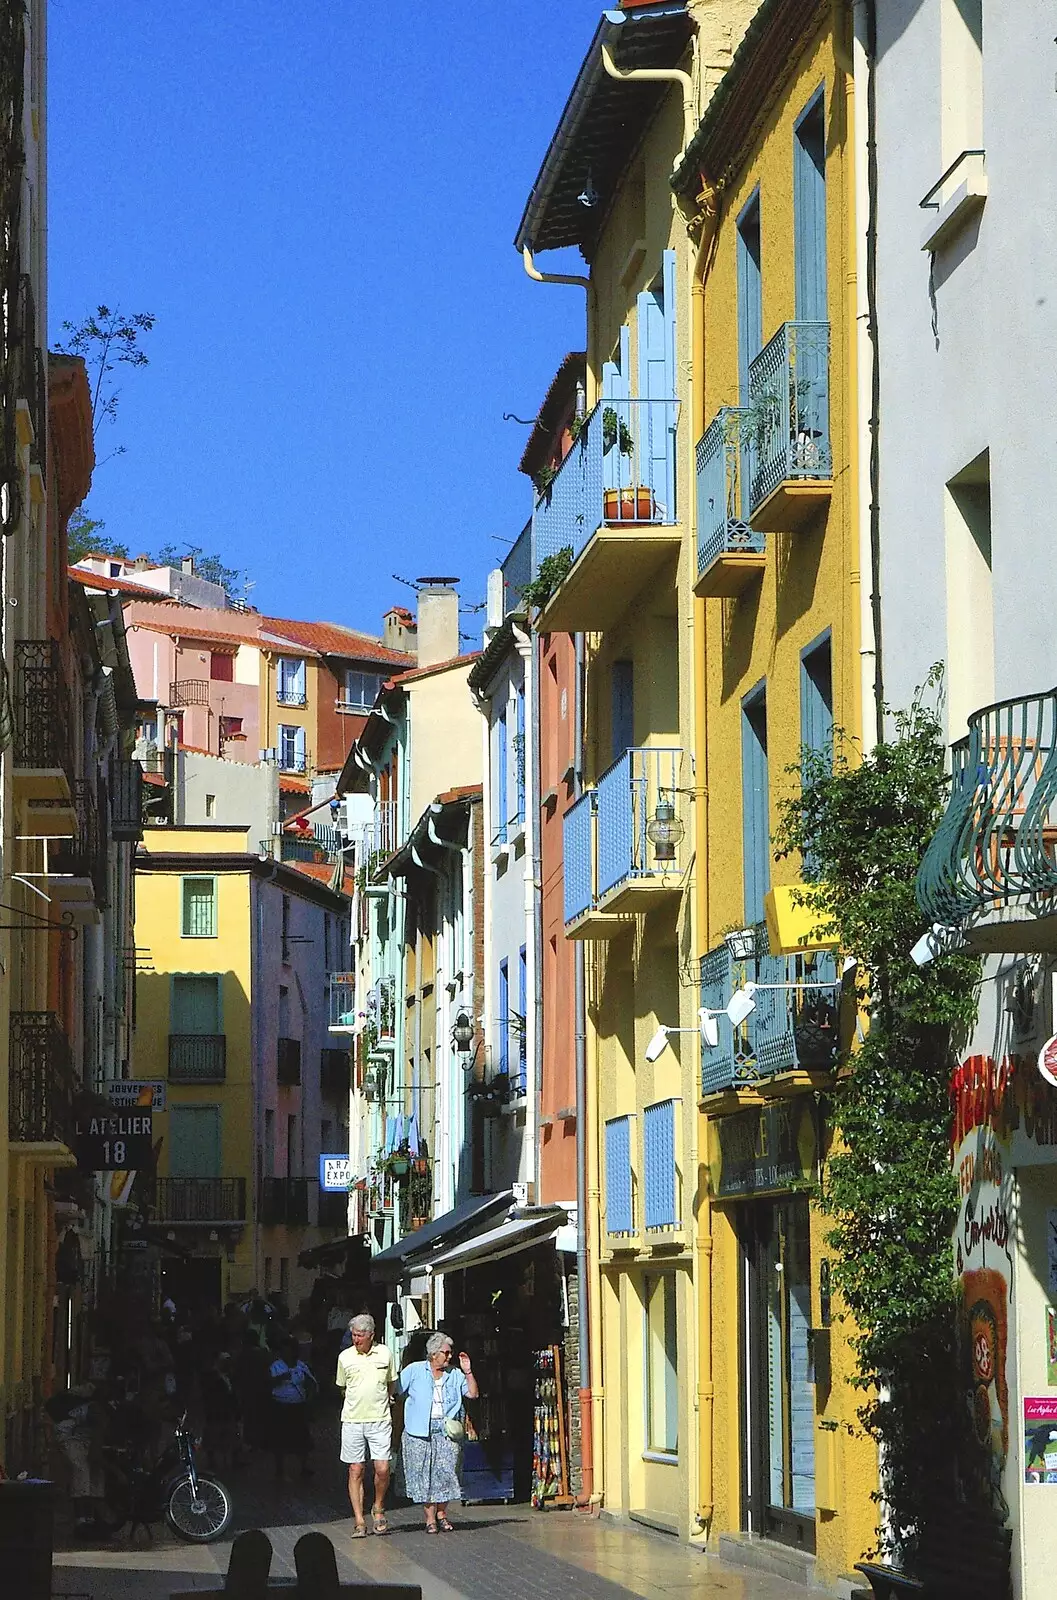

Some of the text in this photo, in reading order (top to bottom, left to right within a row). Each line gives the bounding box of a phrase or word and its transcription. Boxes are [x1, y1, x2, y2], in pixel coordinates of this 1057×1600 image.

[103, 1140, 126, 1164] 18
[328, 1160, 348, 1170] ART
[327, 1171, 350, 1180] EXPO
